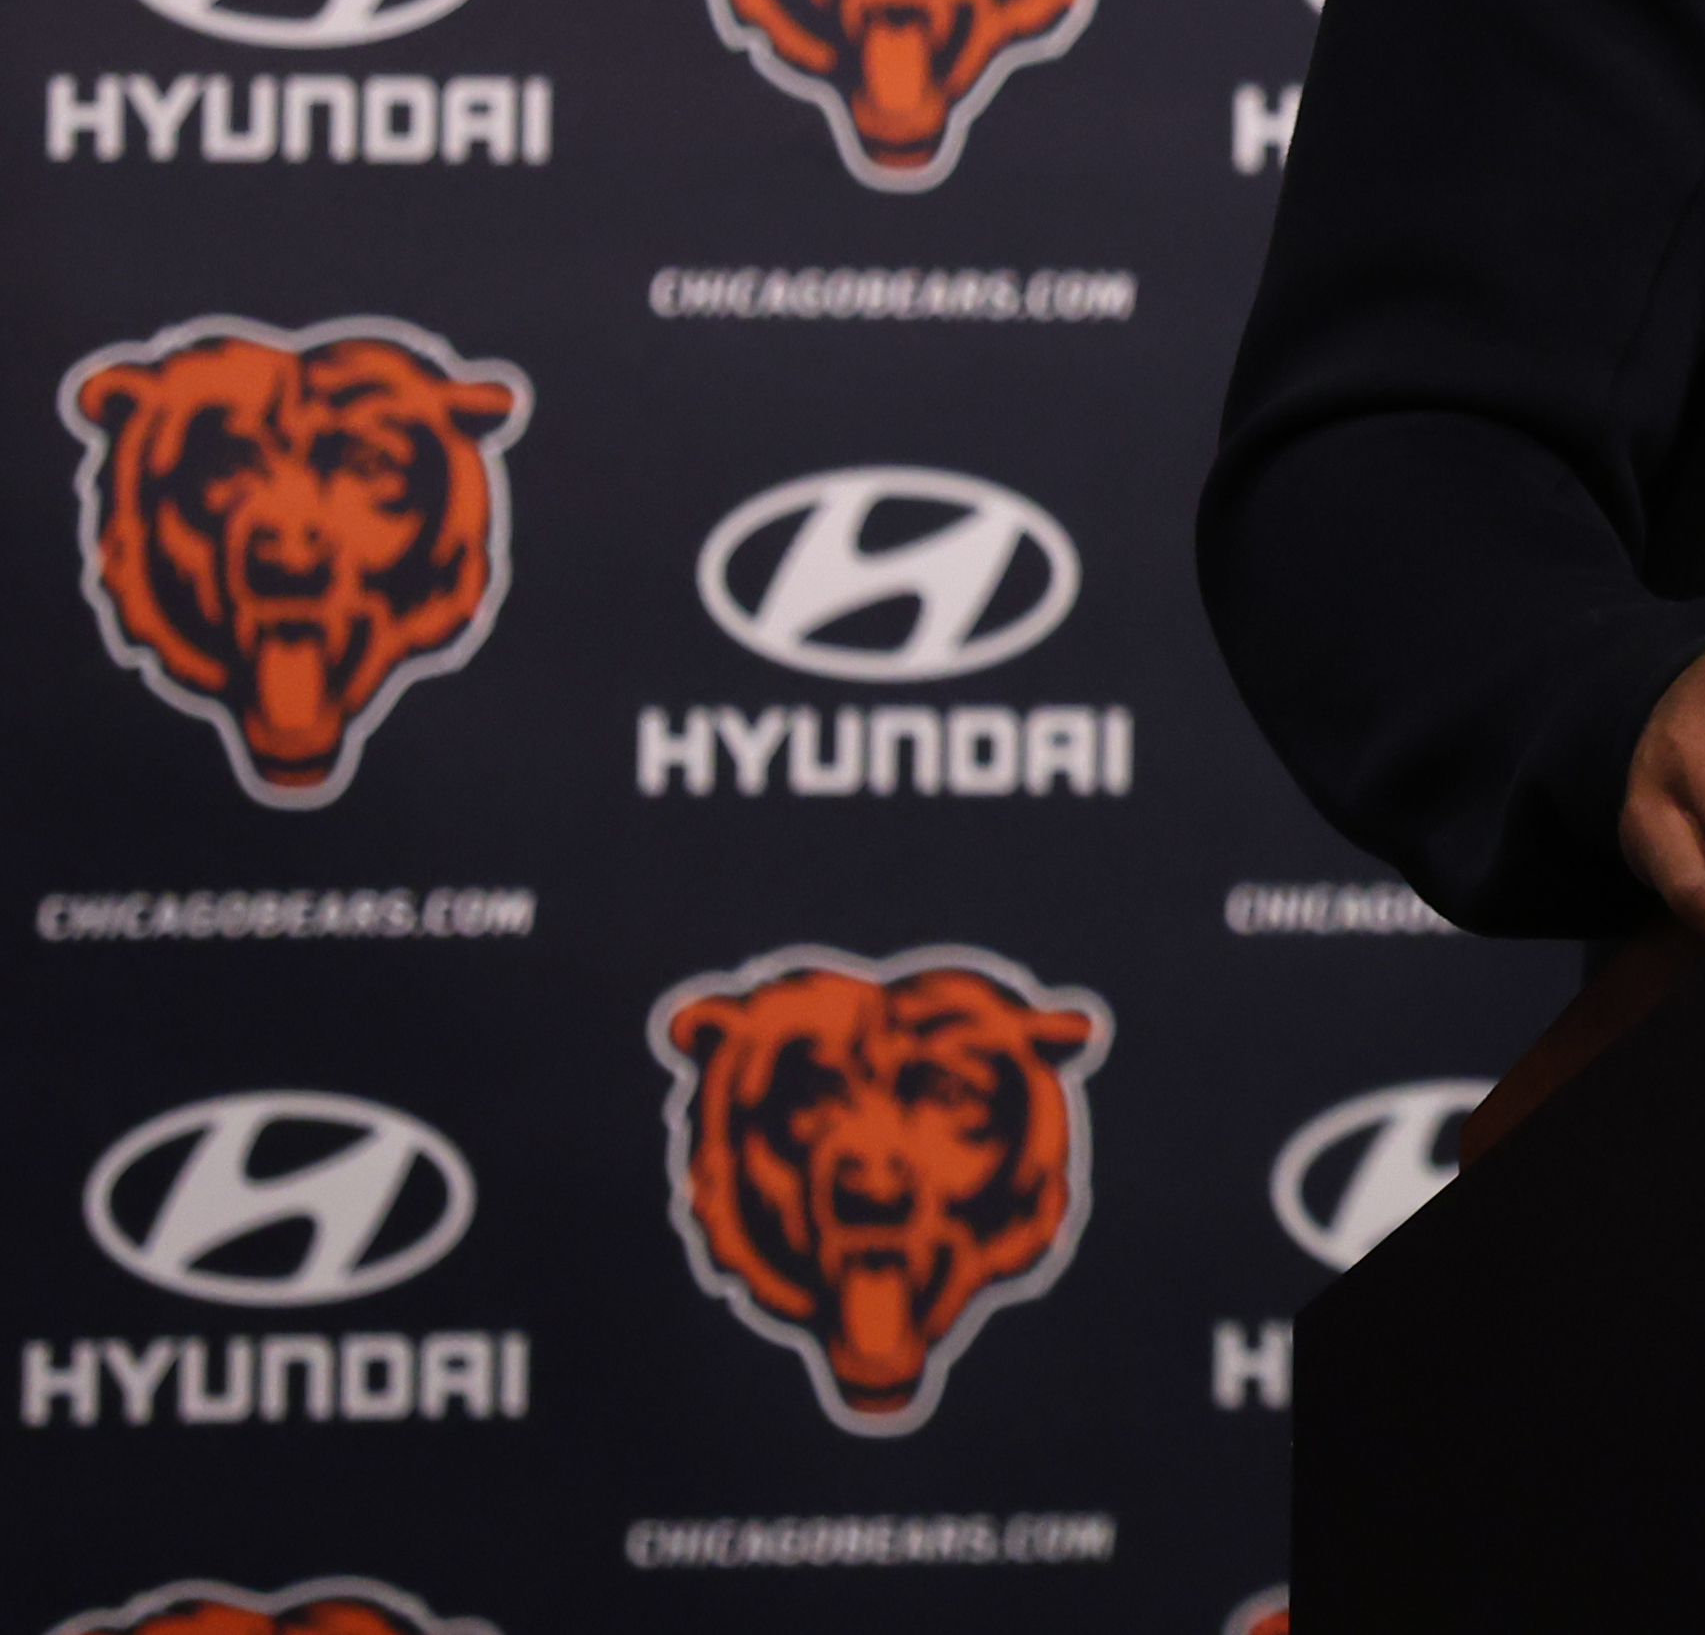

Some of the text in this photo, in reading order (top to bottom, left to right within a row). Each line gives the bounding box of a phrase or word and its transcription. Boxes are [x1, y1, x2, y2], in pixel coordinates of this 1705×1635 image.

[47, 75, 552, 164] HYUNDAI
[649, 269, 1136, 320] CHICAGOBEARS.COM
[637, 707, 1132, 795] HYUNDAI
[37, 889, 536, 939] CHICAGOBEARS.COM
[22, 1332, 529, 1425] HYUNDAI
[626, 1515, 1115, 1567] CHICAGOBEARS.COM
